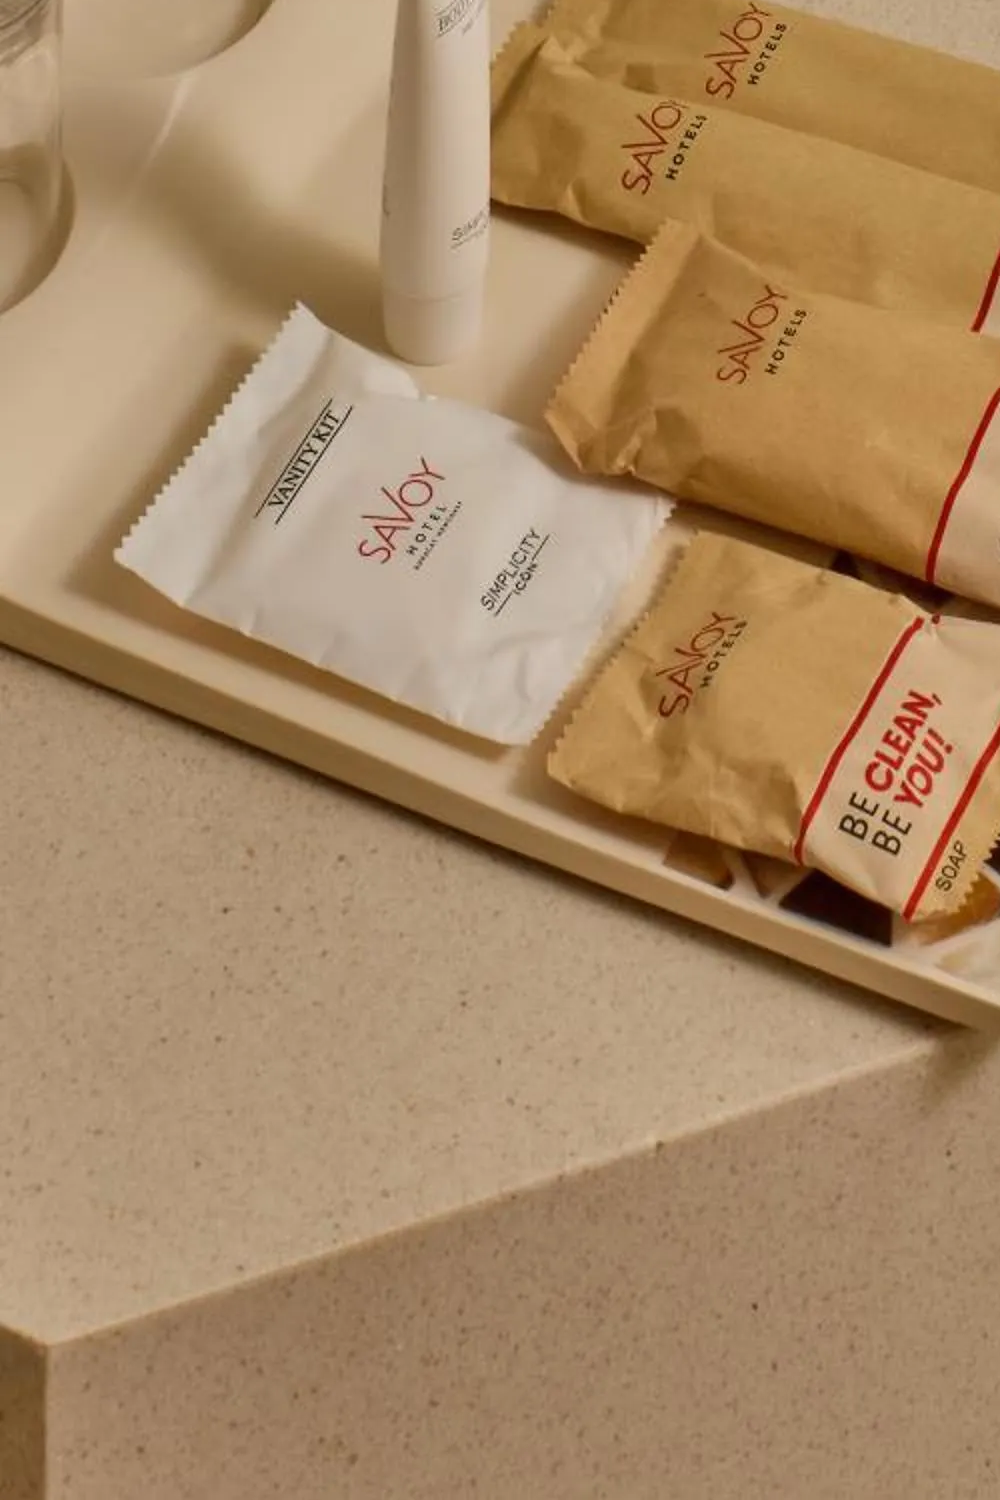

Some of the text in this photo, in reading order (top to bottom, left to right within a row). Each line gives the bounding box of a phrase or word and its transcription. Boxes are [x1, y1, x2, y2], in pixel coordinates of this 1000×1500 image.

[704, 2, 772, 100] SAVOY
[748, 22, 787, 85] HOTELS
[717, 284, 788, 385] SAVOY
[764, 309, 807, 375] HOTELS
[267, 409, 339, 506] VANITY KIT
[358, 456, 446, 565] SAVOY
[406, 504, 449, 557] HOTEL
[480, 528, 544, 611] SIMPLICITY
[656, 611, 737, 717] SAVOY
[838, 690, 943, 841] BE CLEAN,
[871, 728, 954, 856] BE YOU!
[935, 840, 969, 892] SOAP
